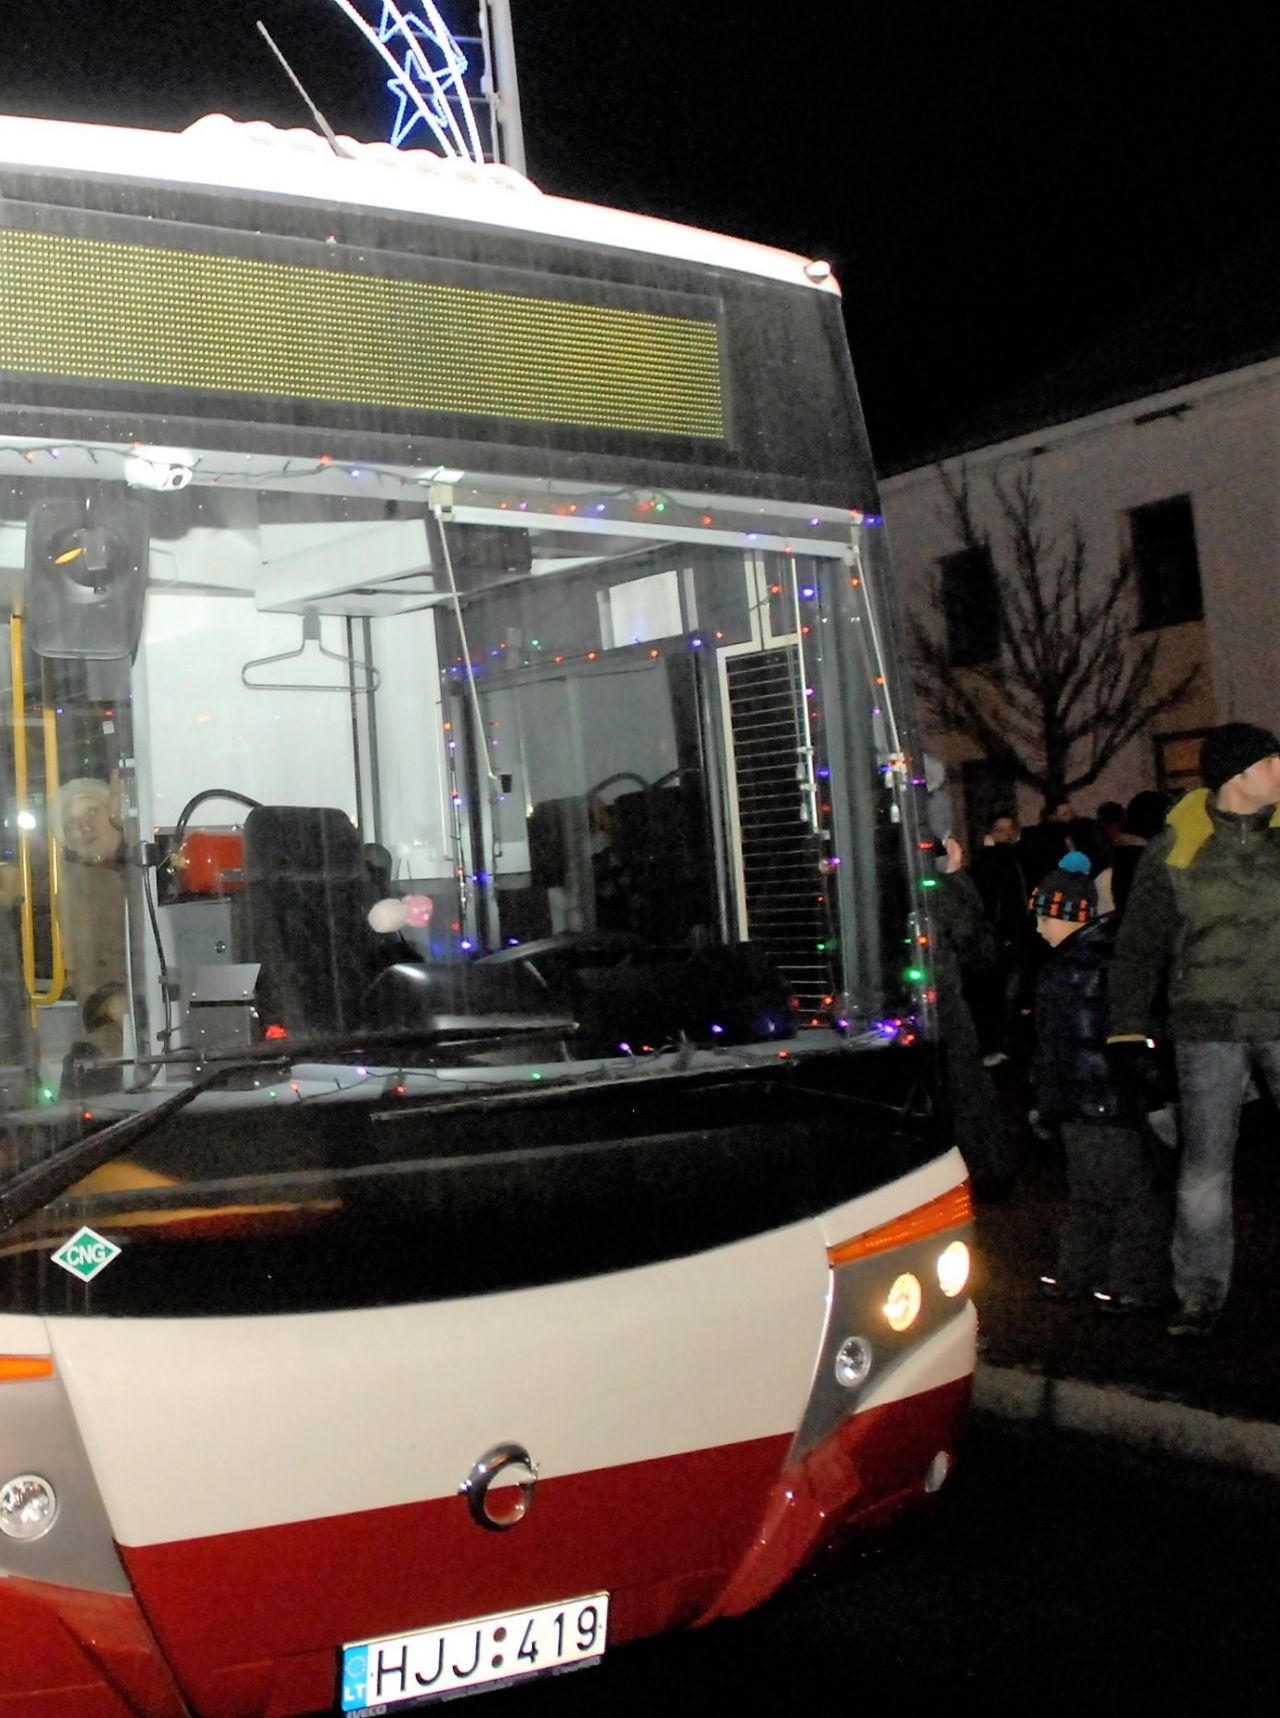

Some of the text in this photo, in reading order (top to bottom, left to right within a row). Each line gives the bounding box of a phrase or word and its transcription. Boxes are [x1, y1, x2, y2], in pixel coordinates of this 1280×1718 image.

[66, 1243, 106, 1266] CNG
[377, 1629, 481, 1697] HJJ
[517, 1605, 598, 1664] 419
[343, 1684, 365, 1701] LT
